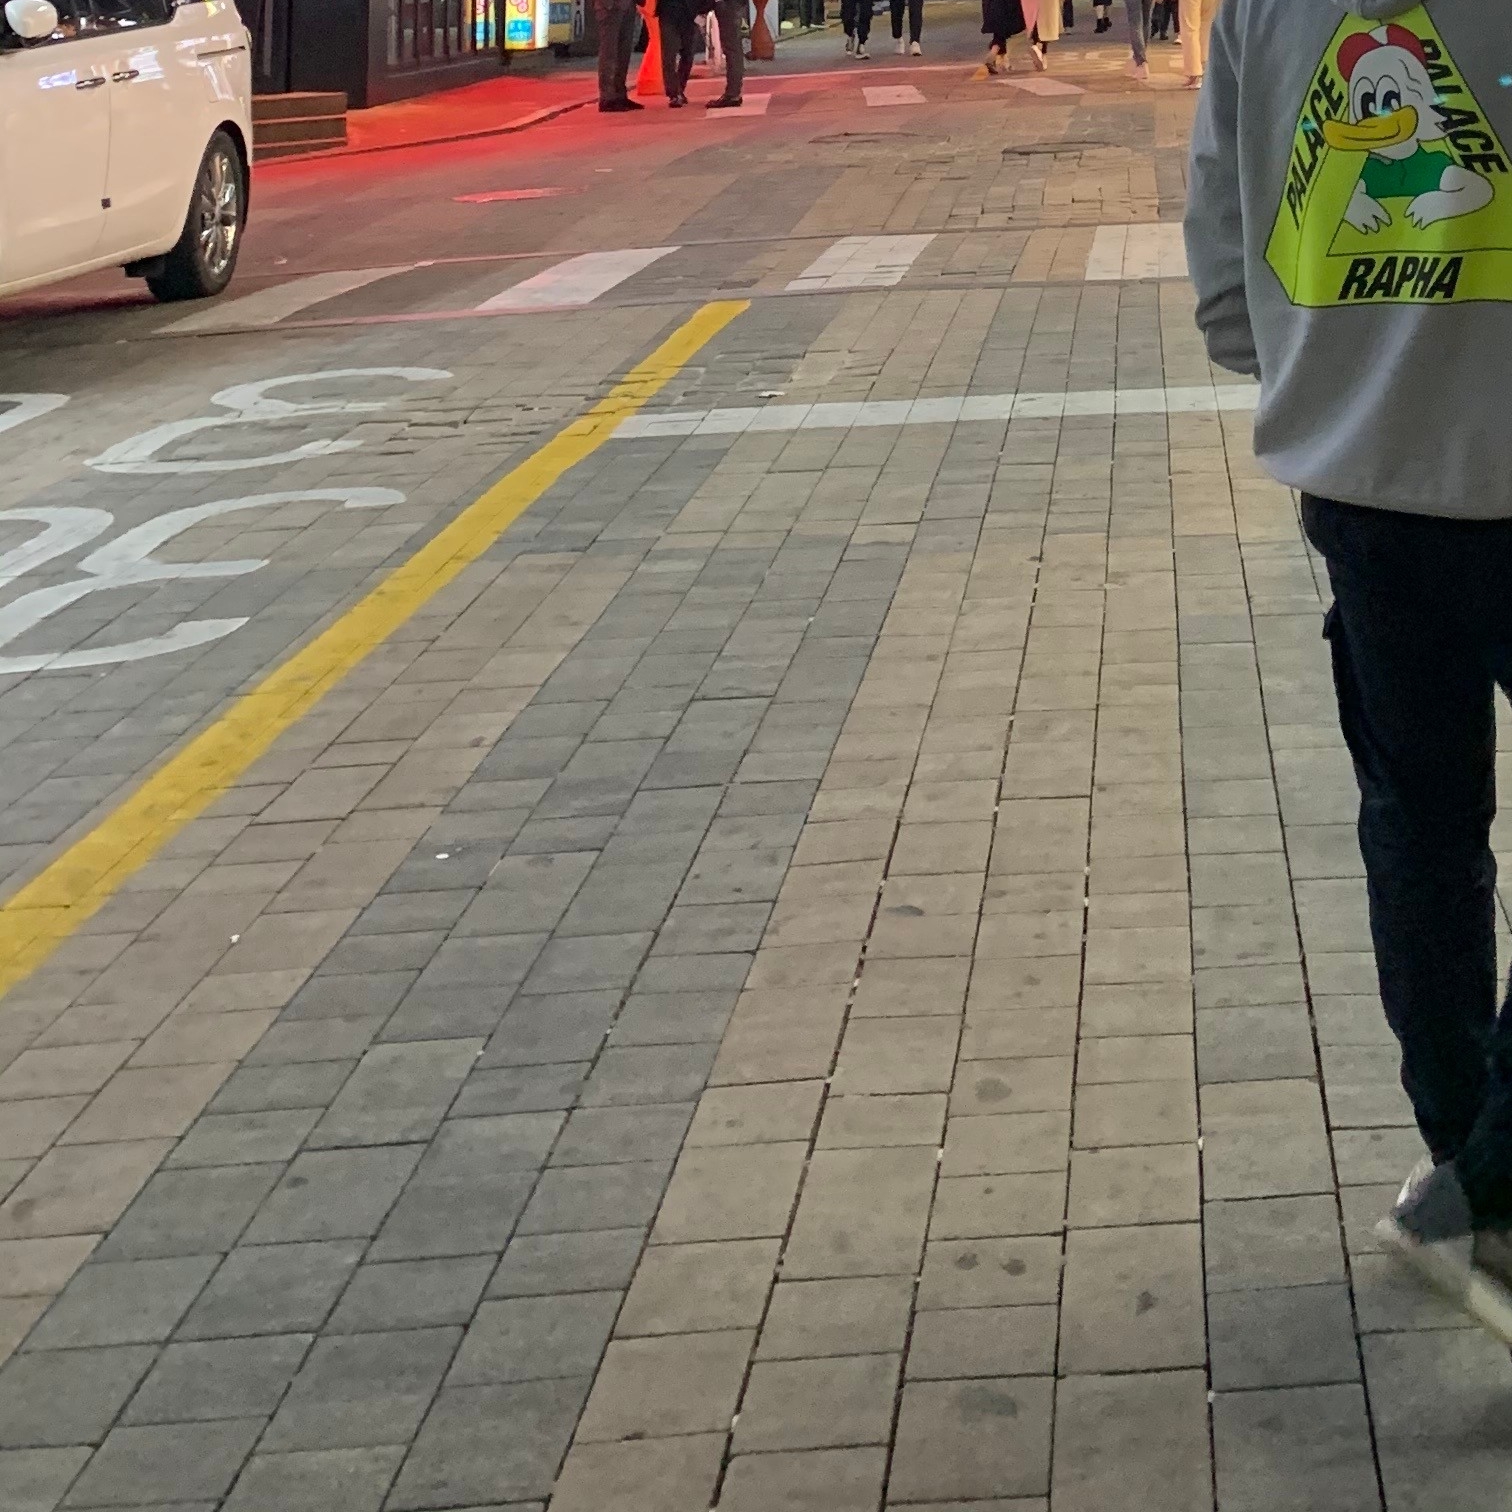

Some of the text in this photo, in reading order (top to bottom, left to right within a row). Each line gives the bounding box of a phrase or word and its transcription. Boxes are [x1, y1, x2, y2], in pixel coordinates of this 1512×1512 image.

[1285, 63, 1346, 231] PALACE
[1419, 37, 1510, 175] PALACE
[1337, 255, 1464, 302] RAPHA
